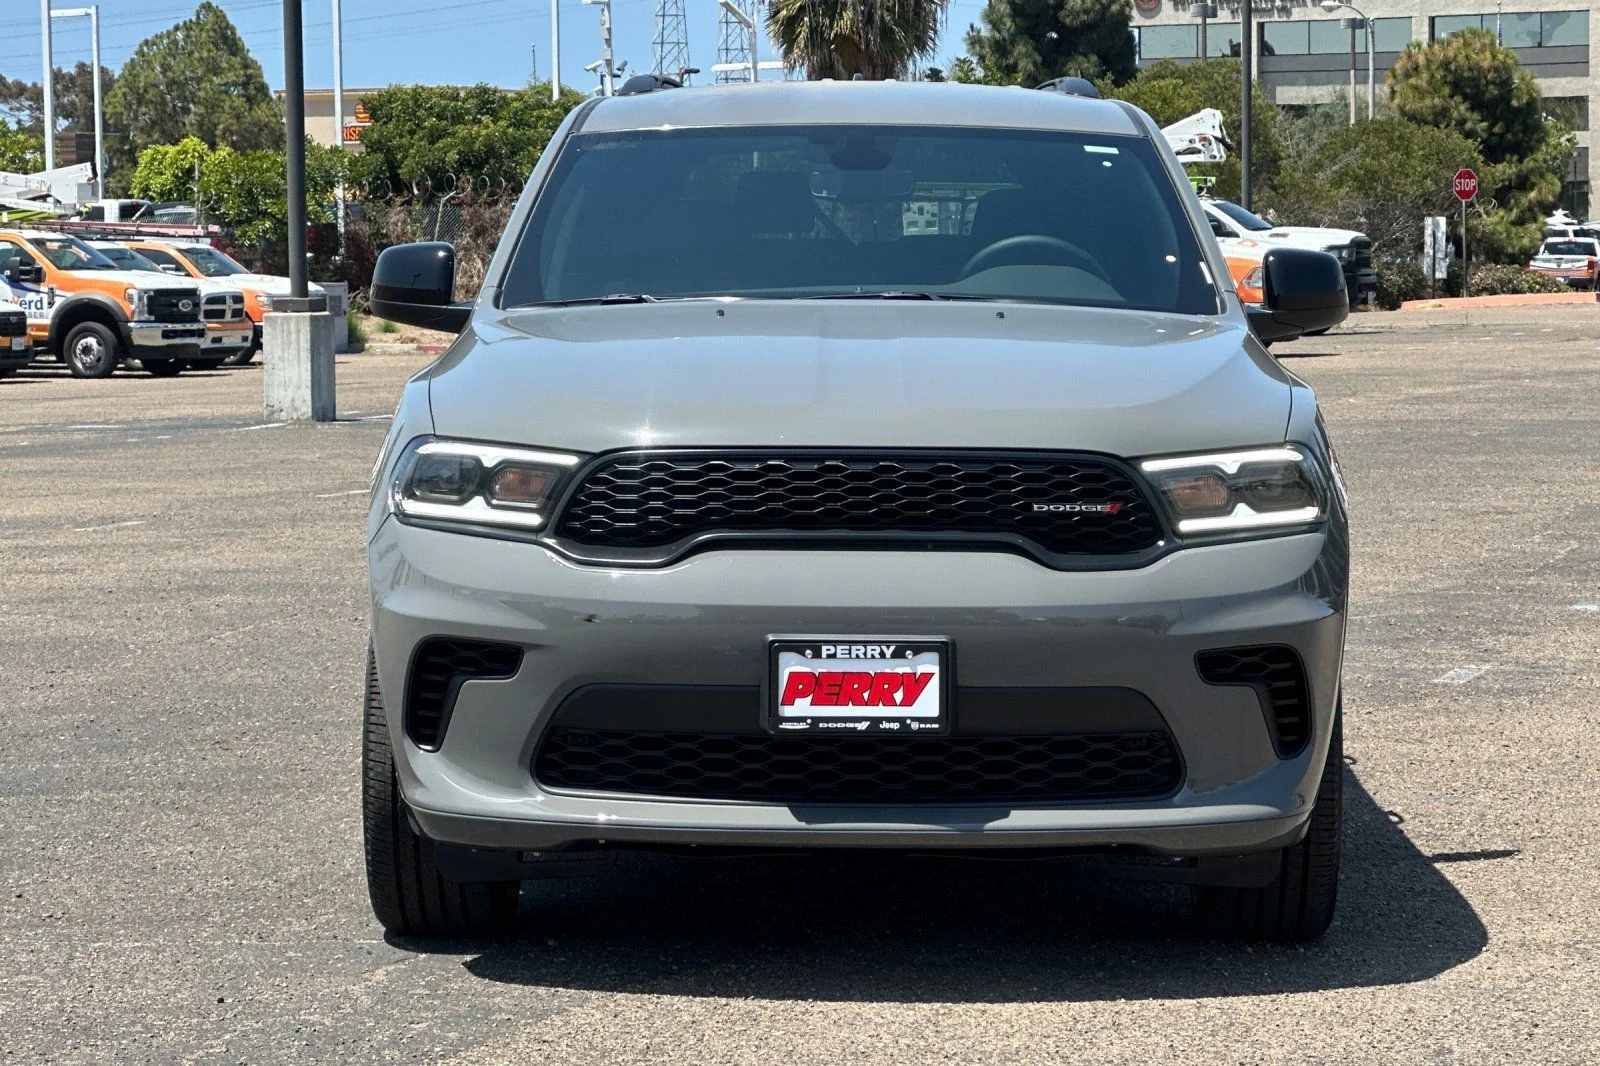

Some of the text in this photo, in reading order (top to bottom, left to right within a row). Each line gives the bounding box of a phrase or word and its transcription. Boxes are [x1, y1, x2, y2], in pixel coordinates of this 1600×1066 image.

[1455, 179, 1476, 191] STOP
[1033, 504, 1111, 512] DODGE
[821, 645, 896, 659] PERRY
[780, 671, 935, 707] PERRY
[879, 720, 900, 731] Jeep
